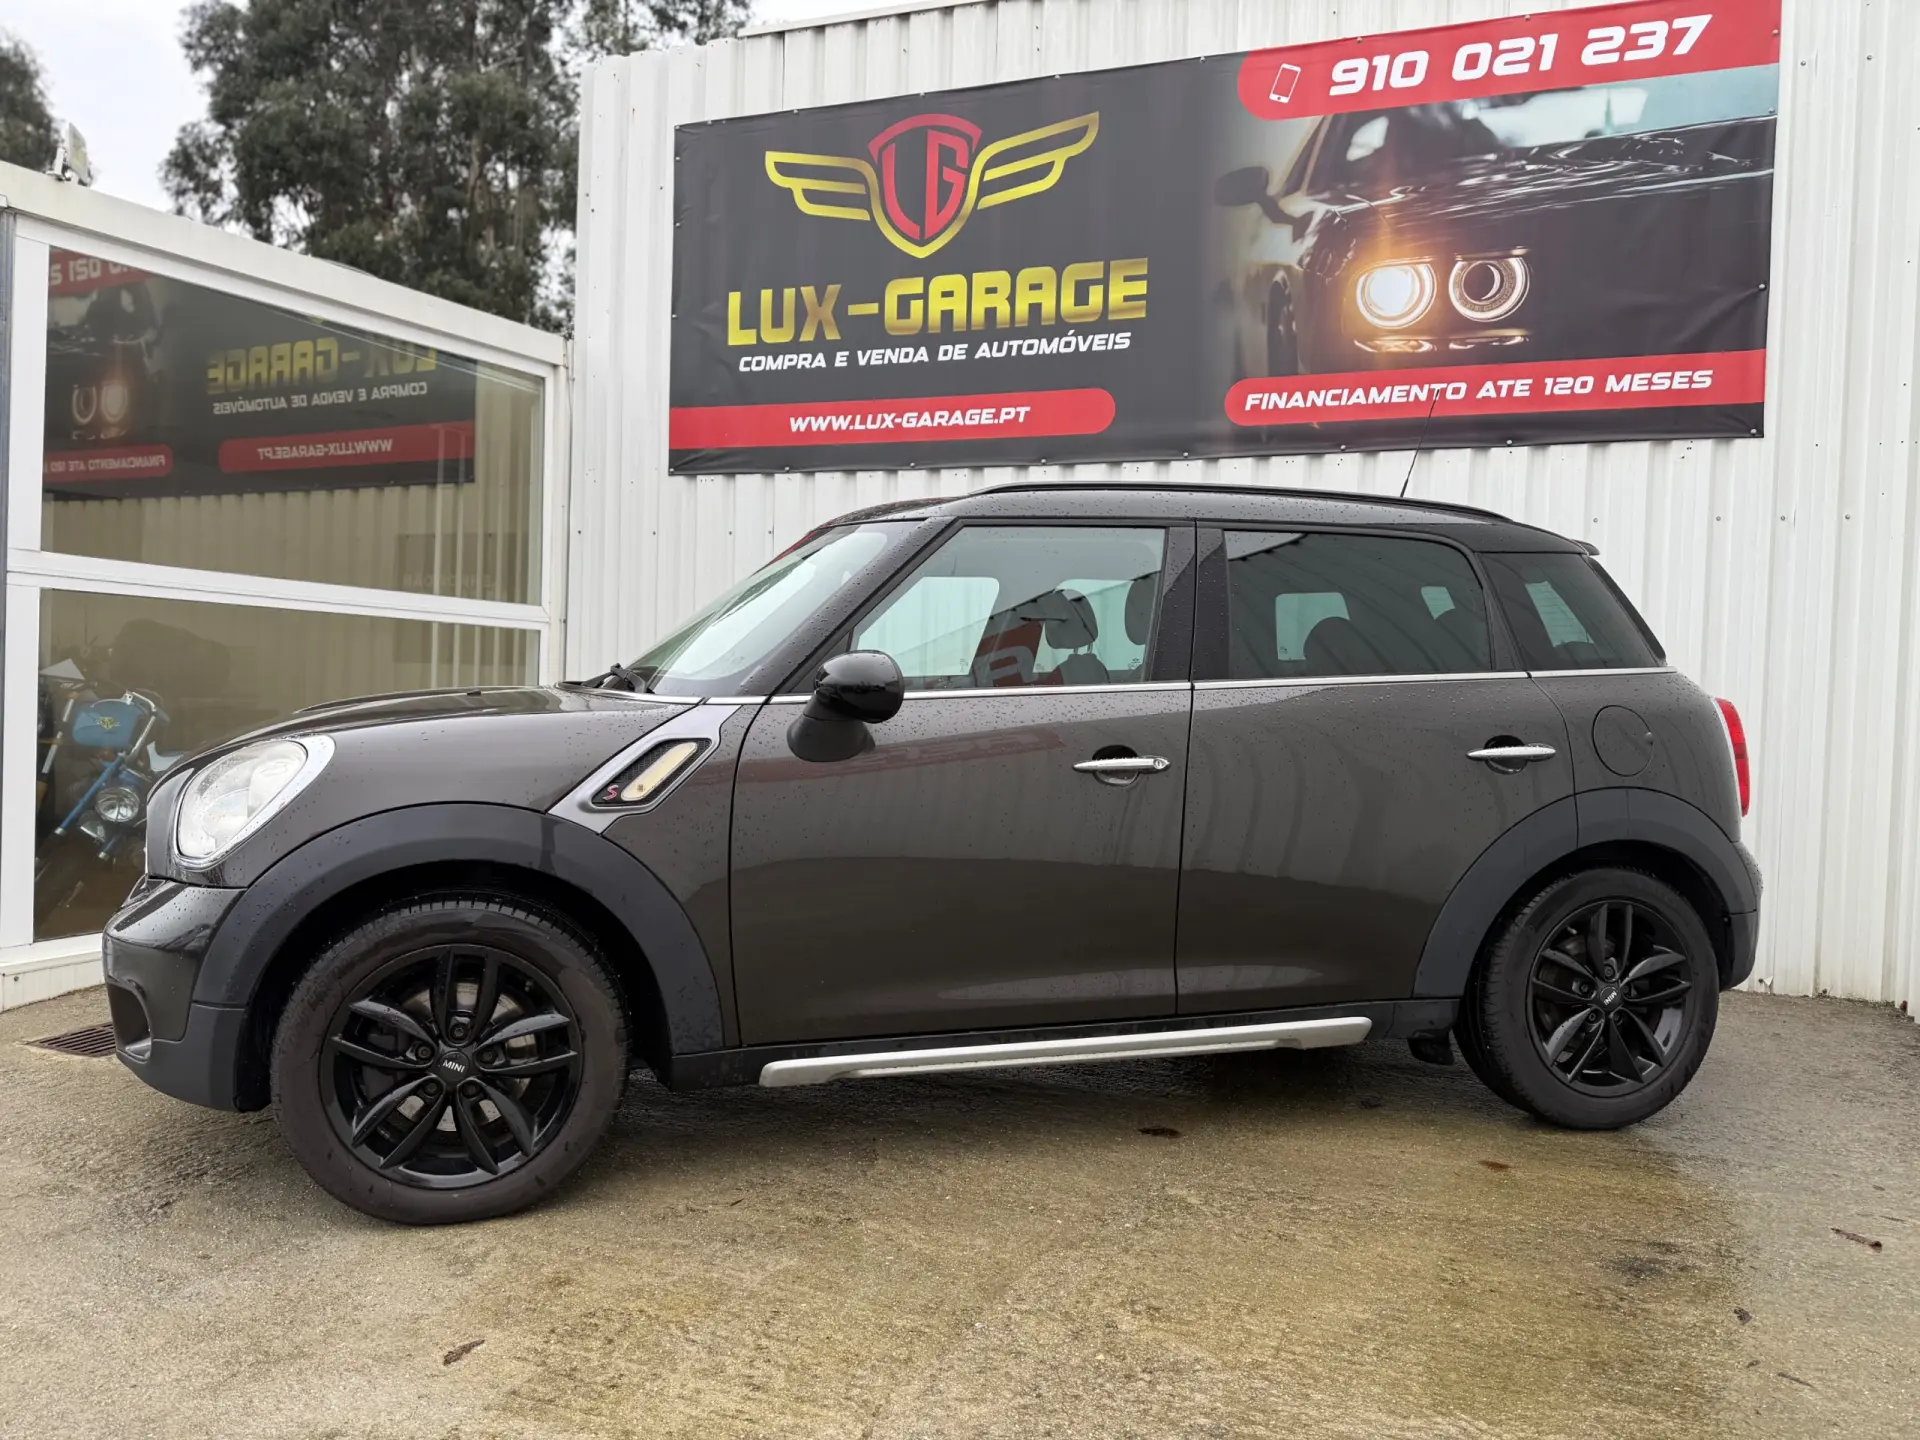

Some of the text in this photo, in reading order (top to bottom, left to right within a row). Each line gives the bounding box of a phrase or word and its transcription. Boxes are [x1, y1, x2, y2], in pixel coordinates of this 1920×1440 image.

[1328, 14, 1713, 96] 910 021 237
[738, 329, 1132, 372] COMPRA E VENDA DE AUTOMÓVEIS
[1244, 370, 1714, 411] FINANCIAMENTO ATE 120 MESES
[789, 406, 1032, 434] WWW.LUX-GARAGE.PT
[603, 784, 619, 801] S
[443, 1060, 465, 1073] MINI
